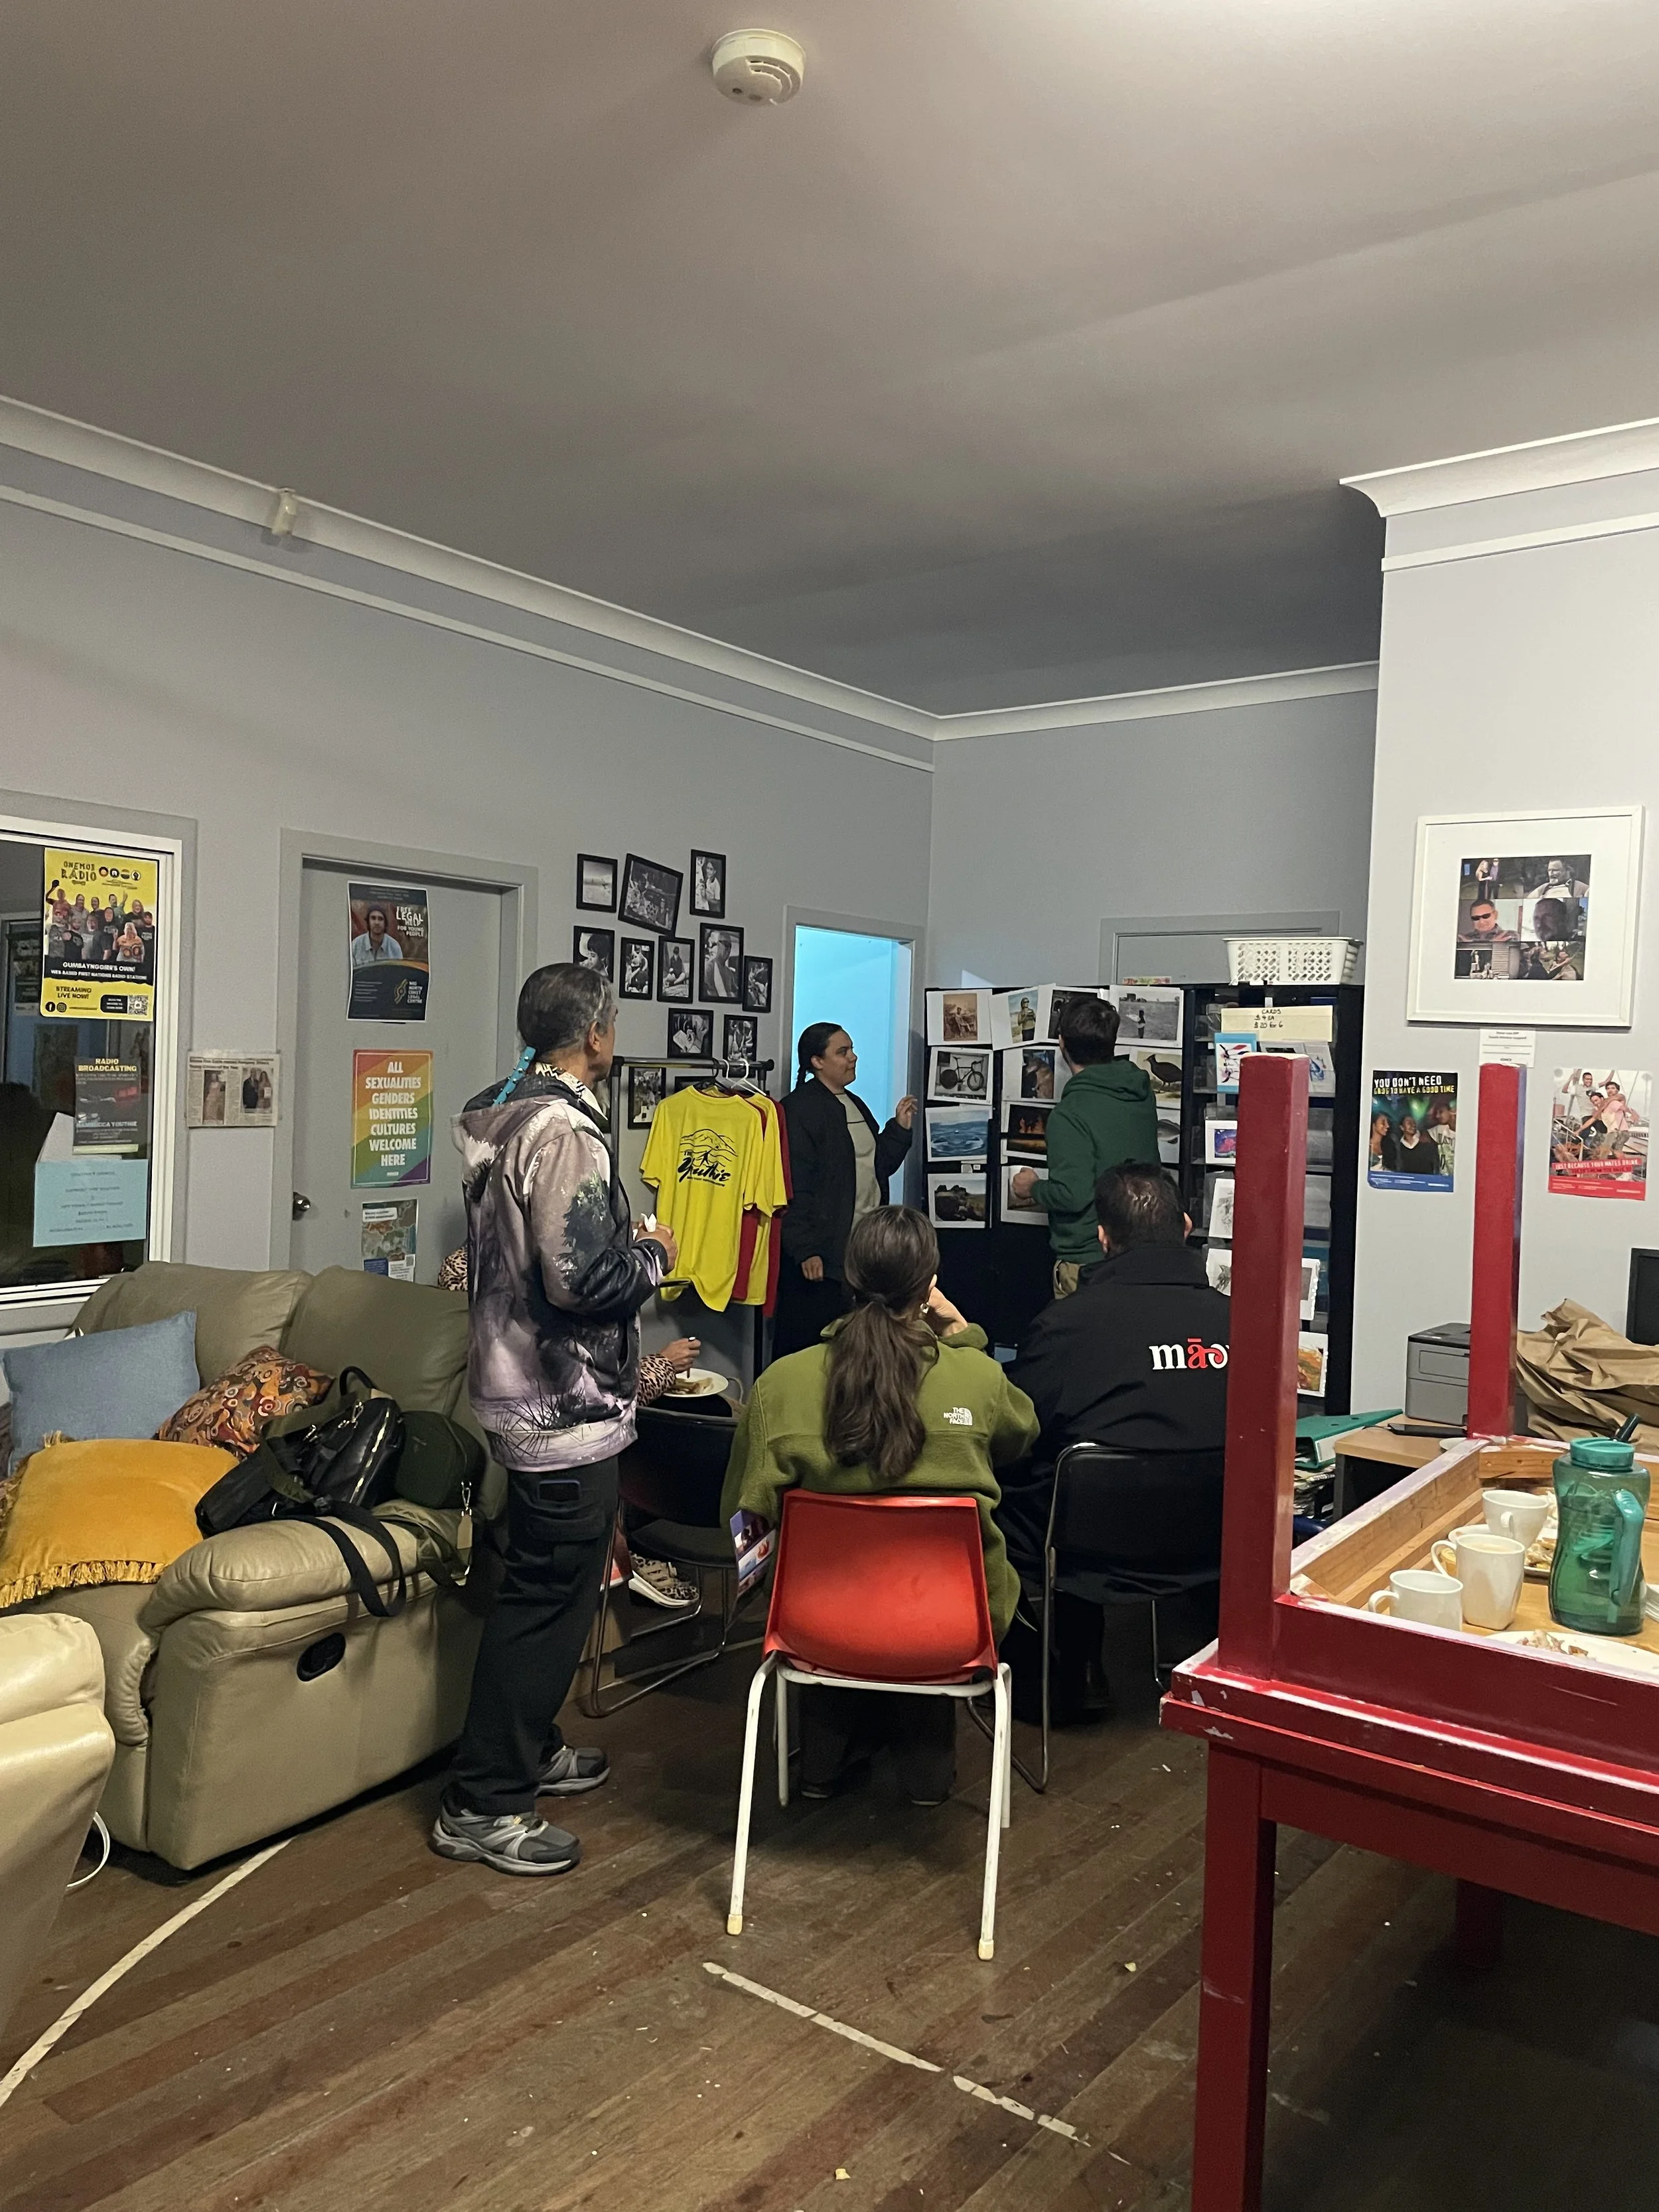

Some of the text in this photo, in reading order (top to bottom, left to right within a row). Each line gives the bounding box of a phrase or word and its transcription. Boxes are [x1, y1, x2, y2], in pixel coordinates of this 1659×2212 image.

[61, 868, 97, 881] RADIO
[396, 912, 423, 922] LEGAL
[388, 1061, 403, 1073] ALL
[366, 1076, 421, 1089] SEXUALITIES
[1374, 1075, 1442, 1088] YOU DON'T NEED
[372, 1092, 415, 1104] GENDERS
[369, 1108, 418, 1120] IDENTITIES
[370, 1123, 416, 1136] CULTURES
[369, 1138, 417, 1151] WELCOME
[381, 1153, 405, 1167] HERE
